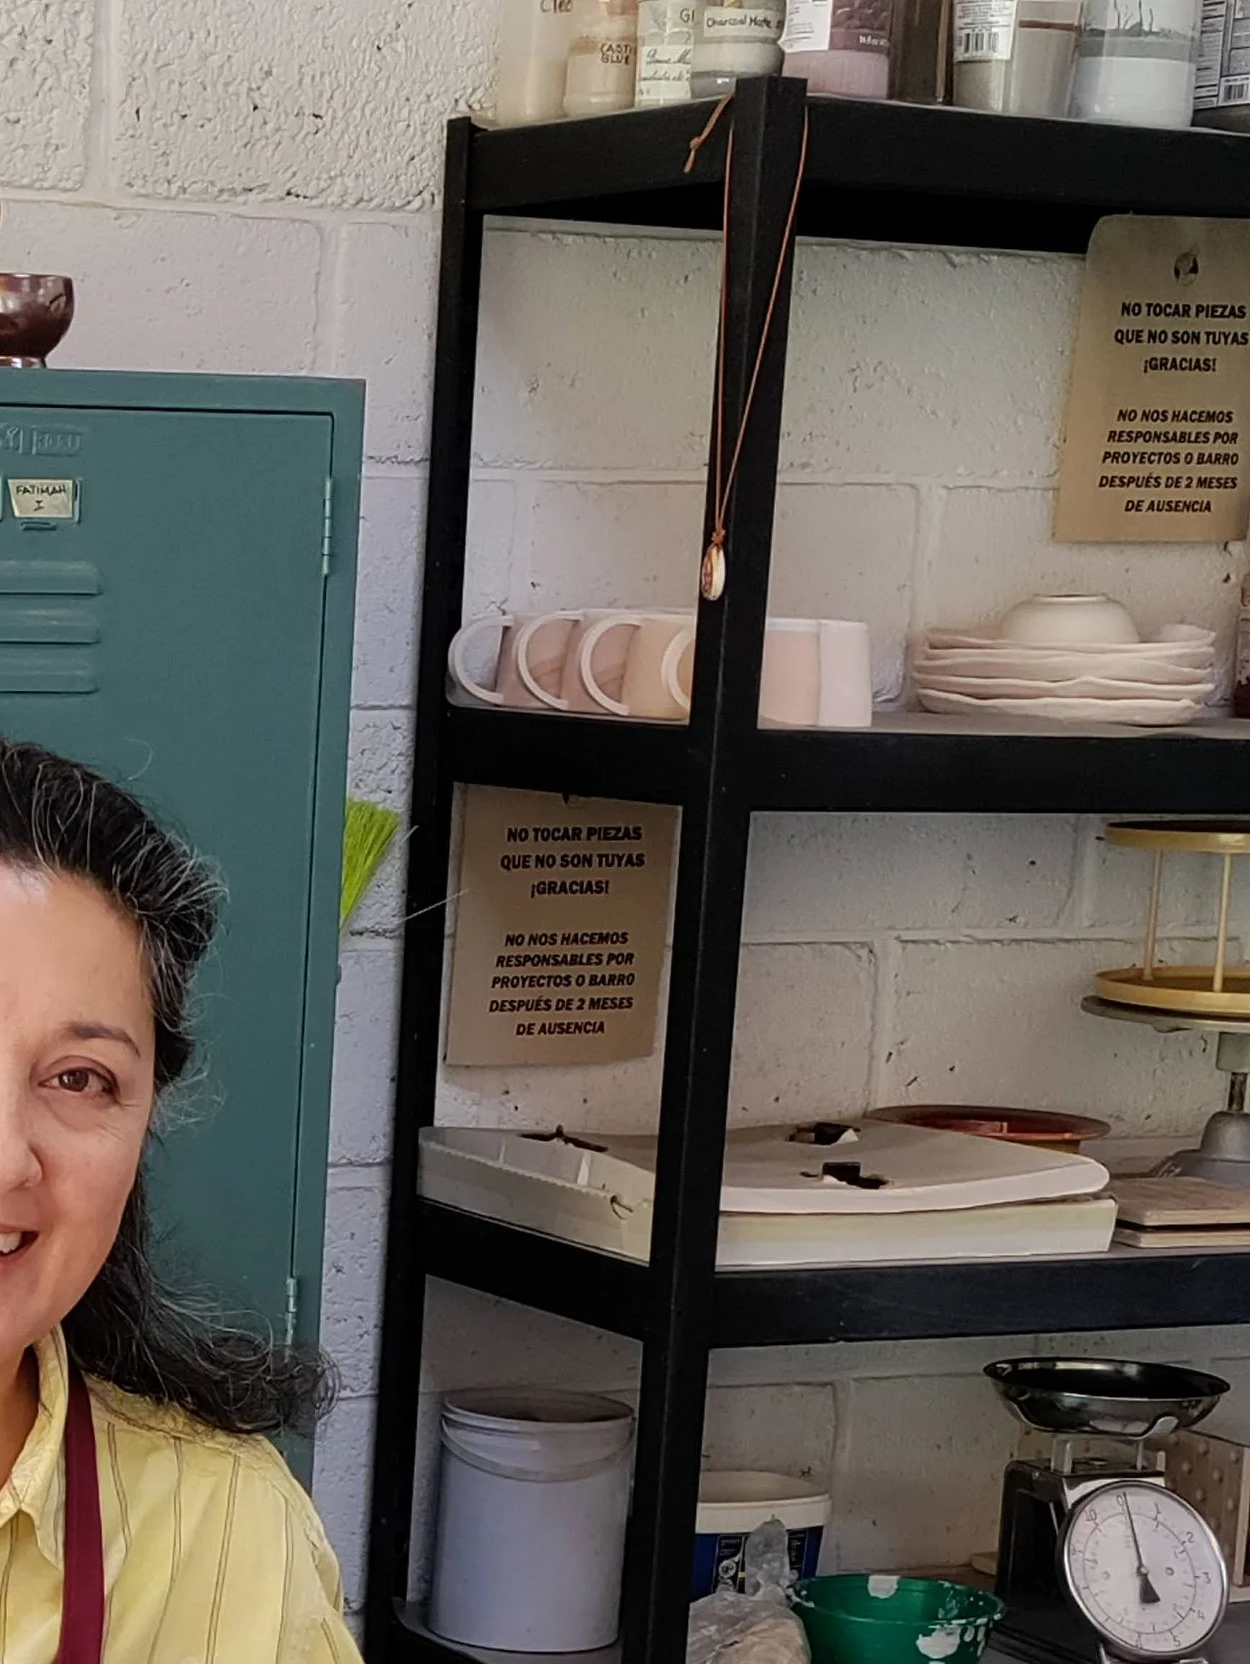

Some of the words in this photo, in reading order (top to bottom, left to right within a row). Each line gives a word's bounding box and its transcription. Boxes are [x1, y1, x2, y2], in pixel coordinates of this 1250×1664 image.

[1121, 302, 1142, 317] NO
[1145, 302, 1191, 318] TOCAR
[1194, 303, 1247, 319] PIEZAS
[1114, 329, 1144, 345] QUE
[1147, 329, 1168, 344] NO
[1171, 330, 1200, 345] SON
[1204, 331, 1249, 346] TUYAS
[1143, 357, 1216, 373] ¡GRACIAS!
[1117, 409, 1138, 422] NO
[1140, 409, 1168, 423] NOS
[1170, 410, 1234, 424] HACEMOS
[1107, 430, 1210, 444] RESPONSABLES
[1212, 431, 1239, 445] POR
[1101, 451, 1181, 465] PROYECTOS
[1184, 452, 1194, 465] O
[1196, 452, 1239, 466] BARRO
[1098, 472, 1162, 489] DESPUÉS
[1164, 476, 1182, 489] DE
[1184, 476, 1194, 489] 2
[1196, 476, 1238, 490] MESES
[1124, 499, 1145, 513] DE
[1145, 500, 1212, 513] AUSENCIA
[507, 827, 529, 842] NO
[532, 827, 583, 842] TOCAR
[586, 826, 643, 841] PIEZAS
[500, 854, 531, 871] QUE
[534, 853, 557, 869] NO
[560, 853, 593, 868] SON
[596, 853, 646, 868] TUYAS
[530, 880, 610, 899] ¡GRACIAS!
[505, 933, 525, 947] NO
[527, 932, 558, 946] NOS
[560, 931, 629, 946] HACEMOS
[495, 953, 603, 968] RESPONSABLES
[606, 952, 635, 966] POR
[491, 974, 572, 989] PROYECTOS
[575, 974, 586, 987] O
[588, 973, 636, 987] BARRO
[488, 994, 552, 1013] DESPUÉS
[555, 998, 573, 1012] DE
[576, 998, 586, 1010] 2
[588, 997, 634, 1010] MESES
[516, 1022, 536, 1036] DE
[537, 1021, 605, 1035] AUSENCIA
